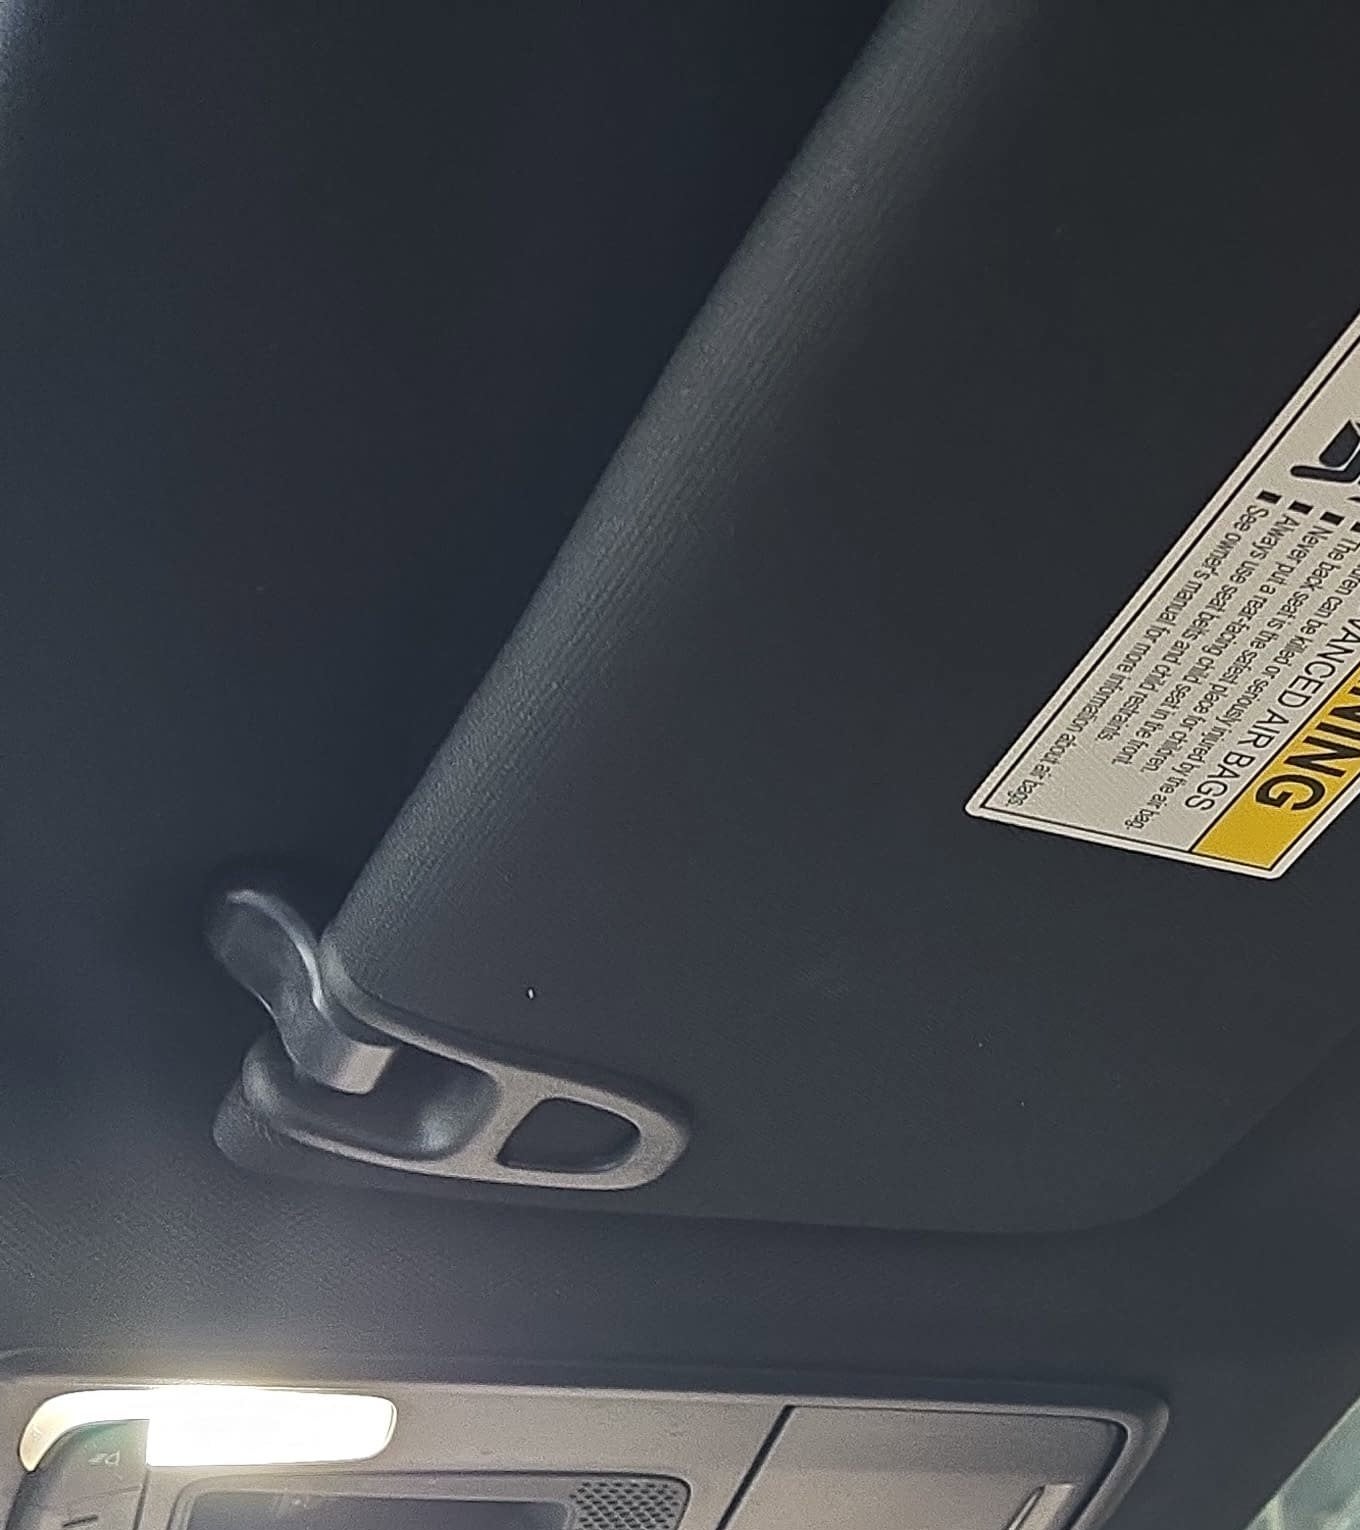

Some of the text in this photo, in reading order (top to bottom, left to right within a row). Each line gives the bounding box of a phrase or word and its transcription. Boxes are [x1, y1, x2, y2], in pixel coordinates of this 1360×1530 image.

[1299, 560, 1341, 591] back
[1276, 591, 1309, 619] seat
[1313, 595, 1343, 618] can
[1094, 513, 1300, 741] Always use seat belts and child restraints.
[1249, 629, 1279, 649] the
[1266, 617, 1291, 630] is
[1299, 618, 1328, 634] be
[1004, 504, 1269, 806] See owner's manual for more information about air bags.
[1111, 525, 1333, 764] Never put a rear-facing child seat in the front.
[1272, 634, 1313, 666] killed
[1218, 649, 1257, 684] safest
[1261, 665, 1280, 679] or
[1192, 682, 1228, 713] place
[1215, 678, 1269, 727] seriously
[1179, 714, 1206, 731] for
[1237, 708, 1289, 748] AIR
[1139, 730, 1188, 772] children.
[1186, 725, 1232, 763] injured
[1170, 761, 1200, 776] by
[1184, 750, 1255, 810] BAGS
[1158, 776, 1187, 793] the
[1146, 793, 1167, 809] air
[1124, 808, 1160, 829] bag.
